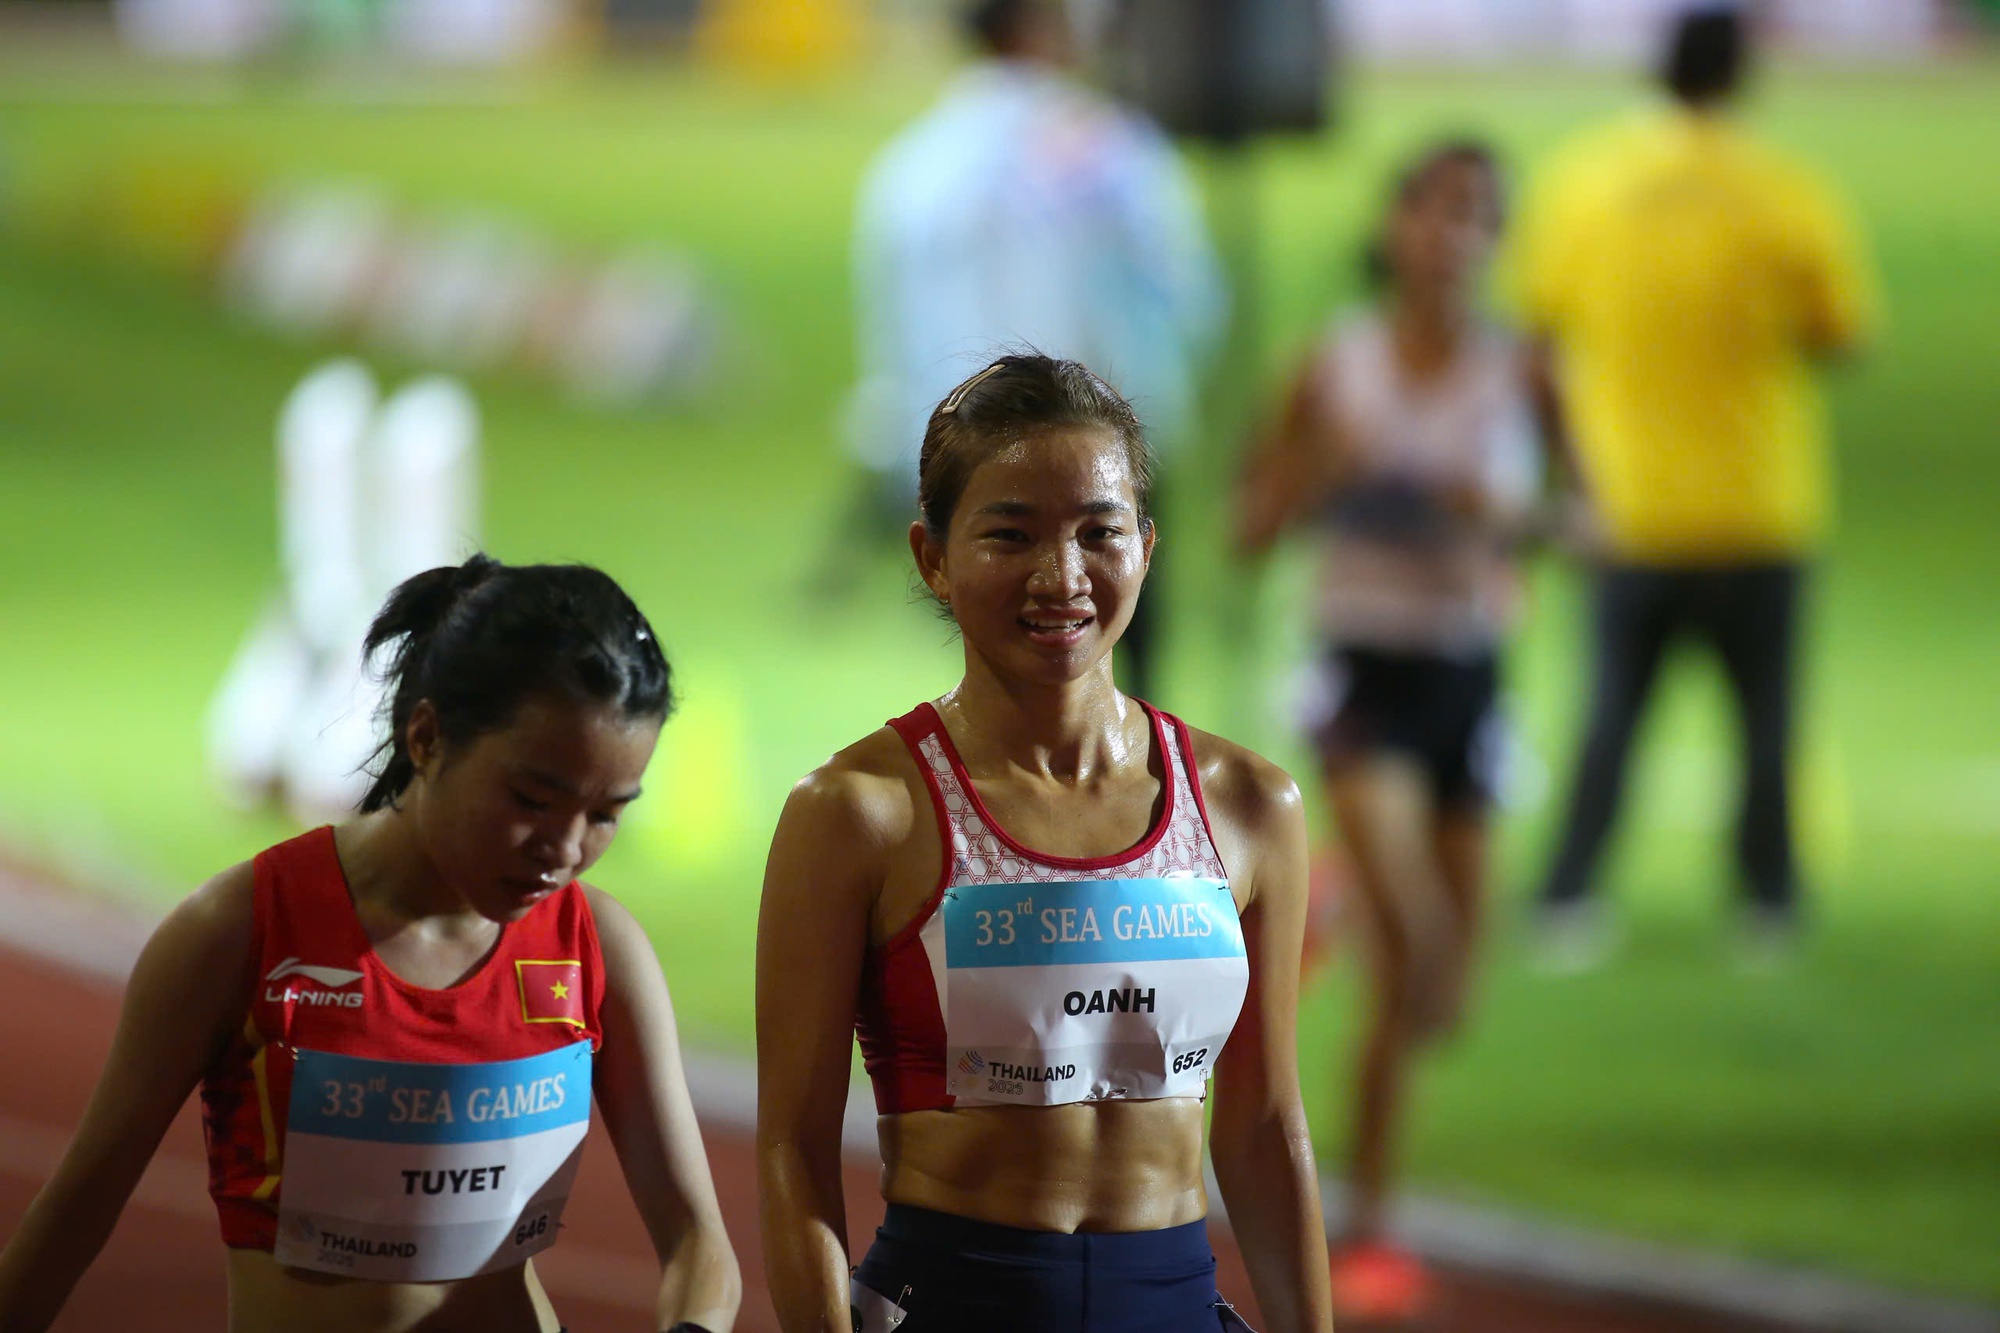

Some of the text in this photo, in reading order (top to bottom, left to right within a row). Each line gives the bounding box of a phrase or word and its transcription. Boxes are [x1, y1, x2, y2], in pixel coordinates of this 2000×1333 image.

[975, 897, 1213, 945] 33rd SEA GAMES
[265, 987, 364, 1008] LI-NING
[1063, 987, 1156, 1016] OANH
[988, 1061, 1076, 1082] THAILAND
[1173, 1048, 1207, 1074] 652
[321, 1072, 566, 1123] 33rd SEA GAMES
[987, 1078, 1024, 1095] 2025
[401, 1165, 505, 1195] TUYET
[515, 1214, 547, 1246] 646
[321, 1231, 417, 1258] THAILAND
